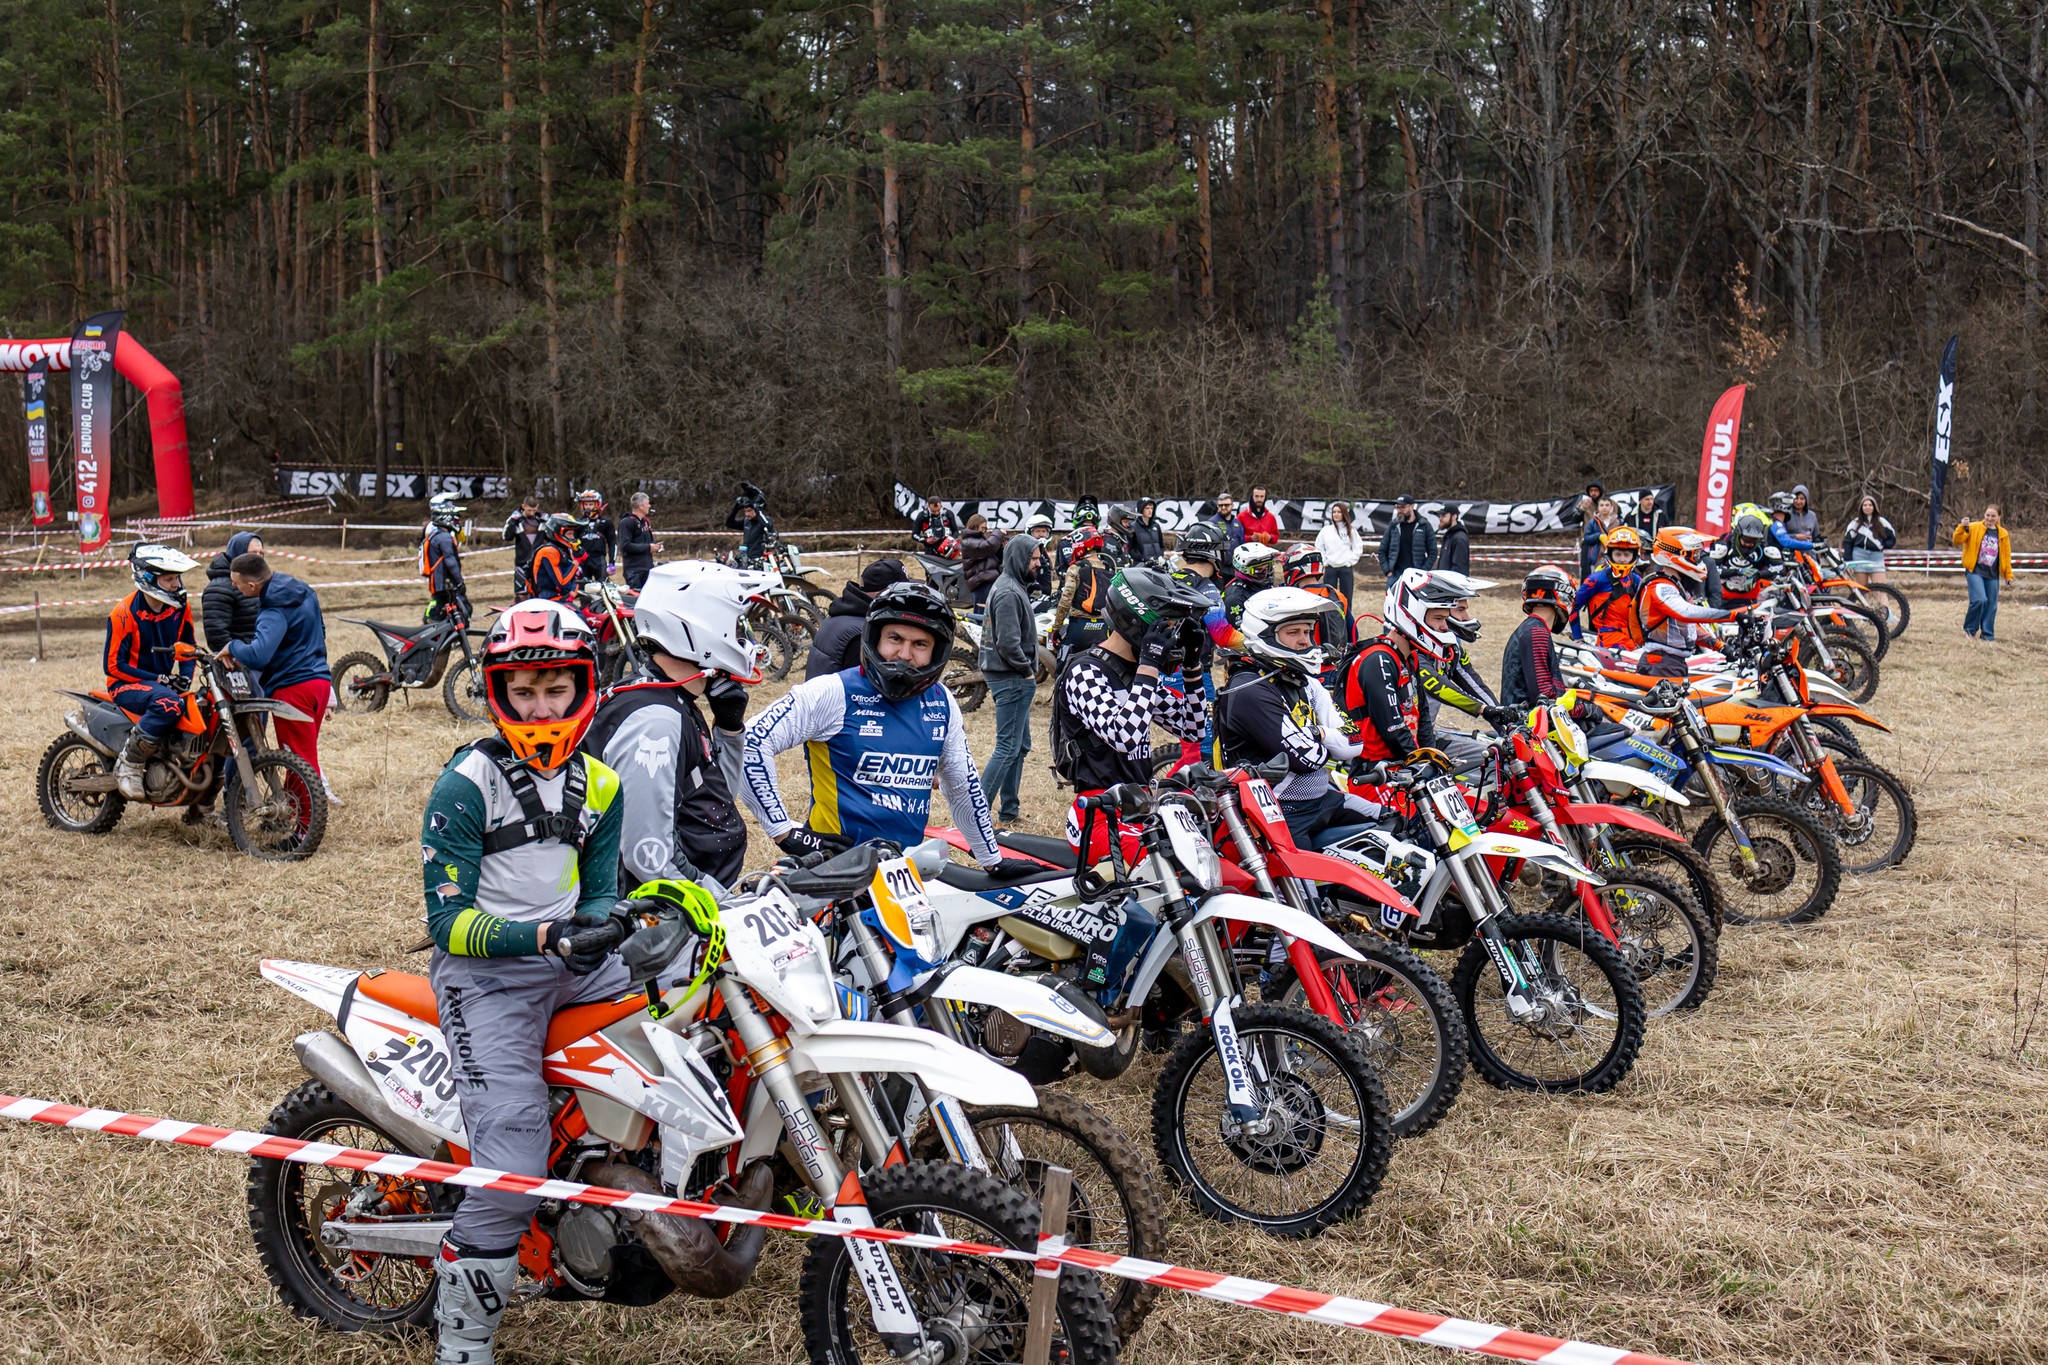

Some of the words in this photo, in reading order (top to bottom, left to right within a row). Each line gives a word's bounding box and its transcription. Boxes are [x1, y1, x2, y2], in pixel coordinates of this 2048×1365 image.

[28, 425, 45, 439] 412
[1934, 374, 1953, 464] ESX
[482, 477, 513, 498] ES
[1705, 418, 1733, 527] MOTUL
[1485, 502, 1564, 533] ESX
[1118, 583, 1149, 615] 100%
[1379, 655, 1400, 719] LEATT
[1743, 713, 1772, 723] KTM
[860, 755, 939, 776] ENDUR
[1625, 736, 1651, 753] MOTO
[1650, 749, 1678, 769] SKILL
[745, 765, 787, 823] UKRAINE
[856, 773, 892, 785] CLUB
[893, 775, 933, 787] UKRAINE
[794, 830, 821, 850] FOX
[886, 868, 921, 900] 227
[743, 904, 801, 948] 205
[1022, 908, 1050, 925] CLUB
[1050, 919, 1094, 944] UKRAINE
[1024, 888, 1118, 942] ENDURO
[1185, 937, 1212, 997] SOGGIO
[1485, 938, 1513, 984] DUNLOP
[275, 975, 309, 994] DUNLOP
[1219, 1025, 1240, 1065] ROCK
[1230, 1067, 1246, 1092] OIL
[399, 1089, 420, 1110] MOTUL
[778, 1099, 824, 1180] SOGGIO
[794, 1107, 820, 1156] DAL
